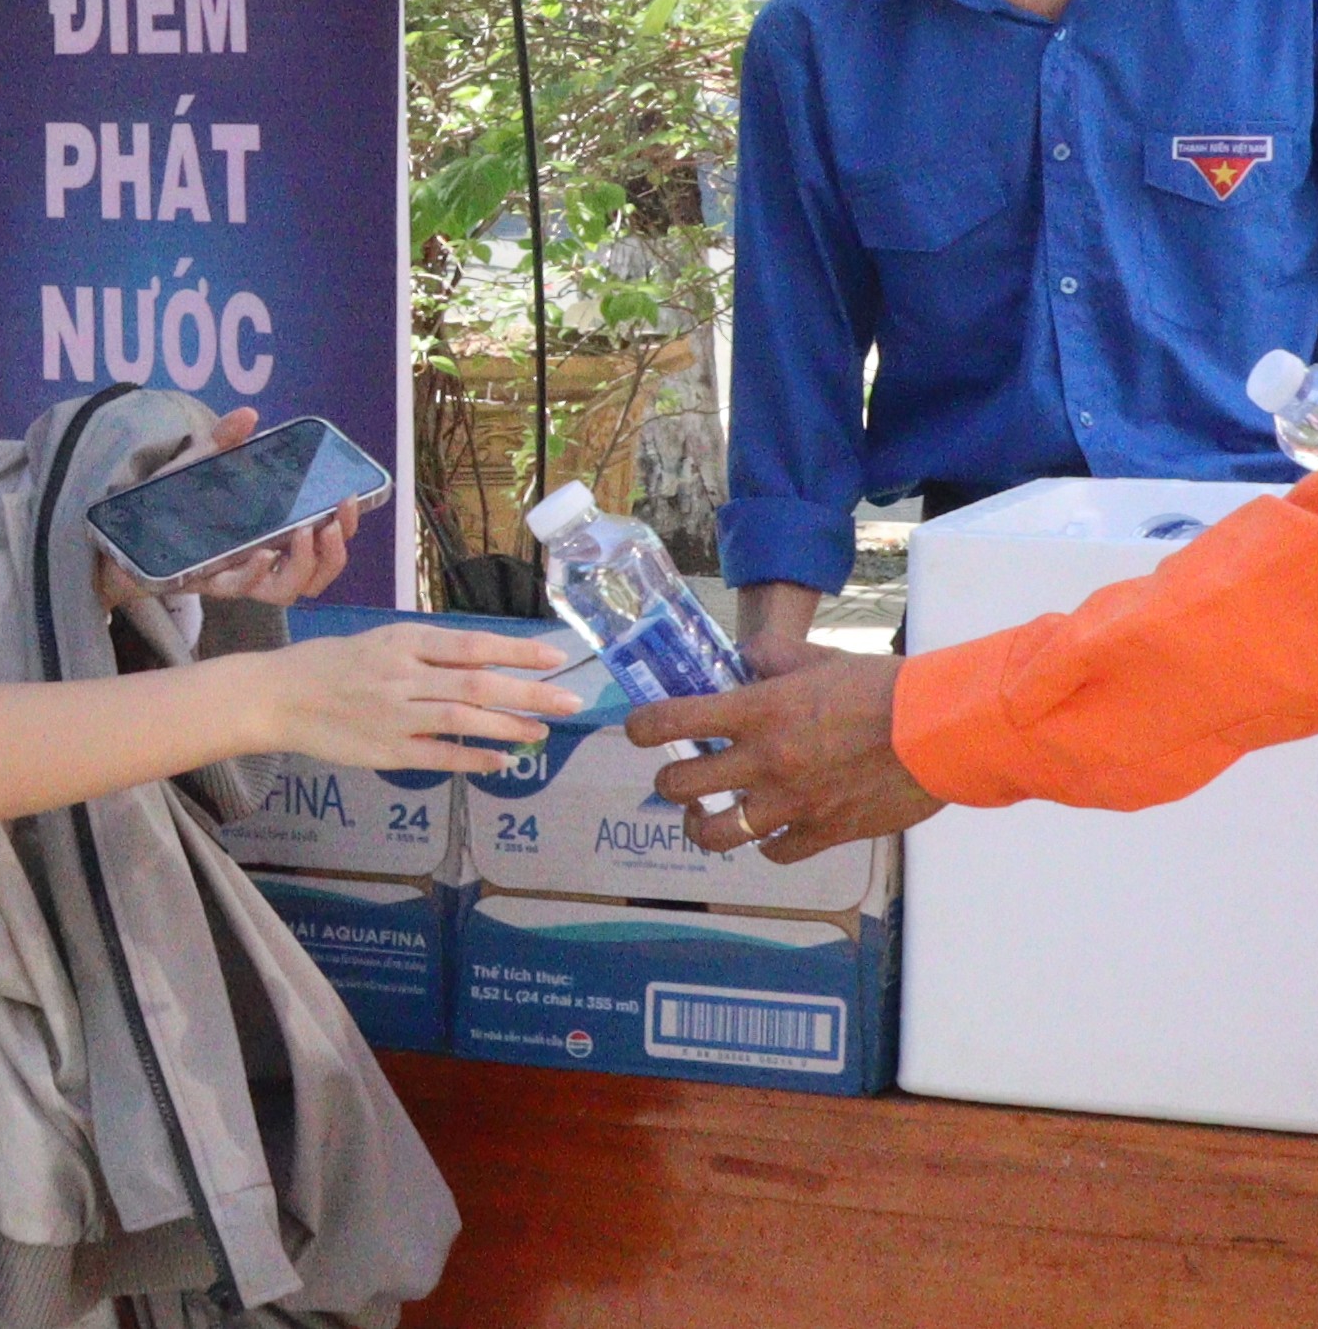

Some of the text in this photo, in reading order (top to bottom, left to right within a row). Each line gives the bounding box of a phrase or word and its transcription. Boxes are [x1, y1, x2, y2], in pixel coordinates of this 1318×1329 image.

[45, 94, 261, 224] PHÁT
[41, 257, 274, 395] NƯỚC
[388, 803, 430, 832] 24
[497, 813, 539, 841] 24
[322, 925, 426, 948] AQUAFINA
[504, 967, 531, 982] tích
[504, 989, 513, 1002] L
[516, 990, 539, 1005] (24
[543, 992, 571, 1008] chai
[574, 999, 583, 1008] x
[587, 996, 613, 1011] 355
[616, 1000, 639, 1015] ml)
